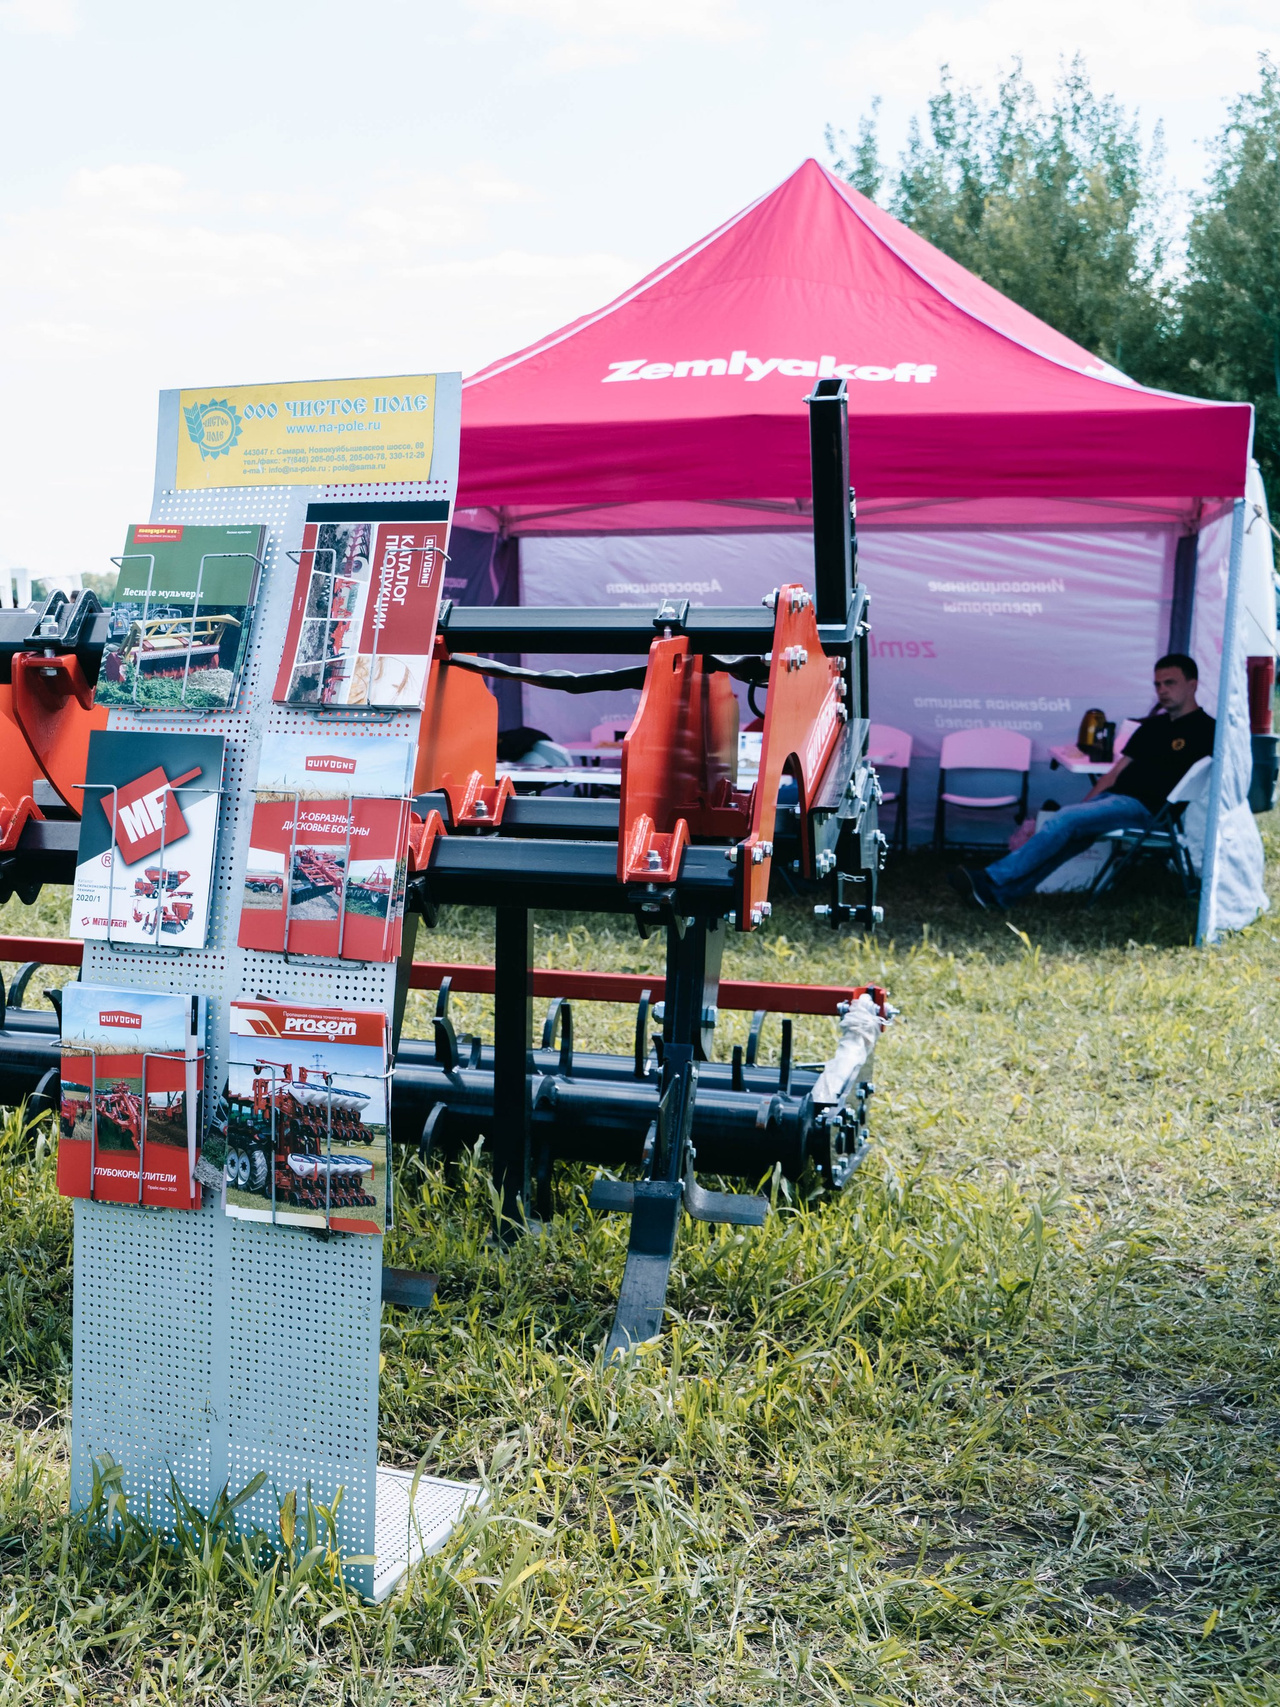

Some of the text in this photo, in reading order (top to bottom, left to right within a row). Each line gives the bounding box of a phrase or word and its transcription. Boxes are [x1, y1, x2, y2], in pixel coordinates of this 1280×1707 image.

[601, 350, 937, 383] Zemlyakoff
[243, 394, 428, 420] ООО ЧИСТОЕ ПОЛЕ
[286, 420, 381, 434] www.na-pole.ru
[243, 448, 268, 456] 443047
[276, 447, 307, 457] Самара,
[392, 535, 415, 606] КАТАЛОГ
[421, 538, 434, 585] QUIVOGNE
[372, 535, 399, 630] ПРОДУКЦИИ
[307, 759, 354, 769] QUIVOGNE
[118, 783, 172, 843] MF
[282, 820, 370, 836] ДИСКОВЫЕ БОРОНЫ
[76, 893, 100, 902] 2020/1
[101, 1015, 141, 1025] QUIVOGNE
